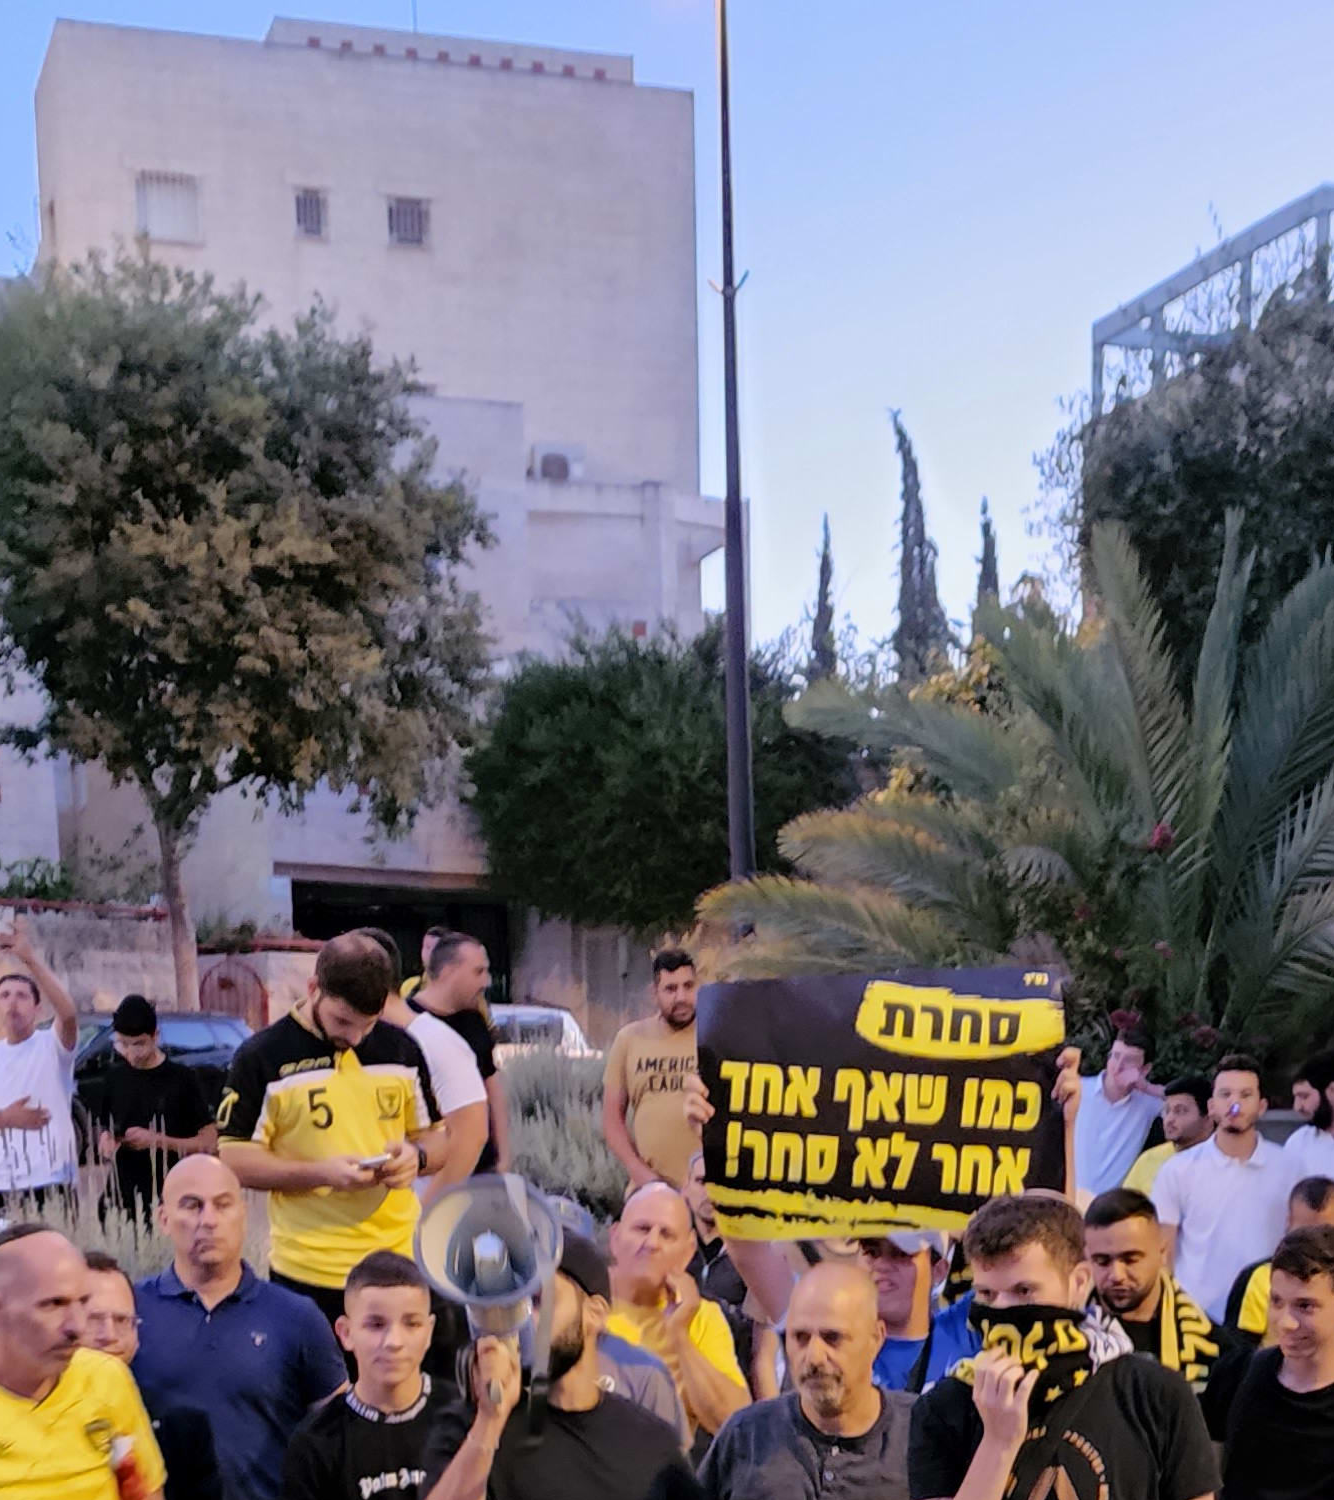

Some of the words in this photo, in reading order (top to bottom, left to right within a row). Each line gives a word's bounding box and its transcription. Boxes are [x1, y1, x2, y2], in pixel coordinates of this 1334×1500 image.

[878, 1001, 1022, 1047] סחרת
[308, 1087, 334, 1130] 5
[720, 1060, 820, 1120] אחד
[833, 1071, 948, 1132] שאף
[960, 1078, 1042, 1132] כמו
[725, 1122, 839, 1182] סחר!
[851, 1131, 920, 1189] לא
[932, 1144, 1031, 1196] אחר
